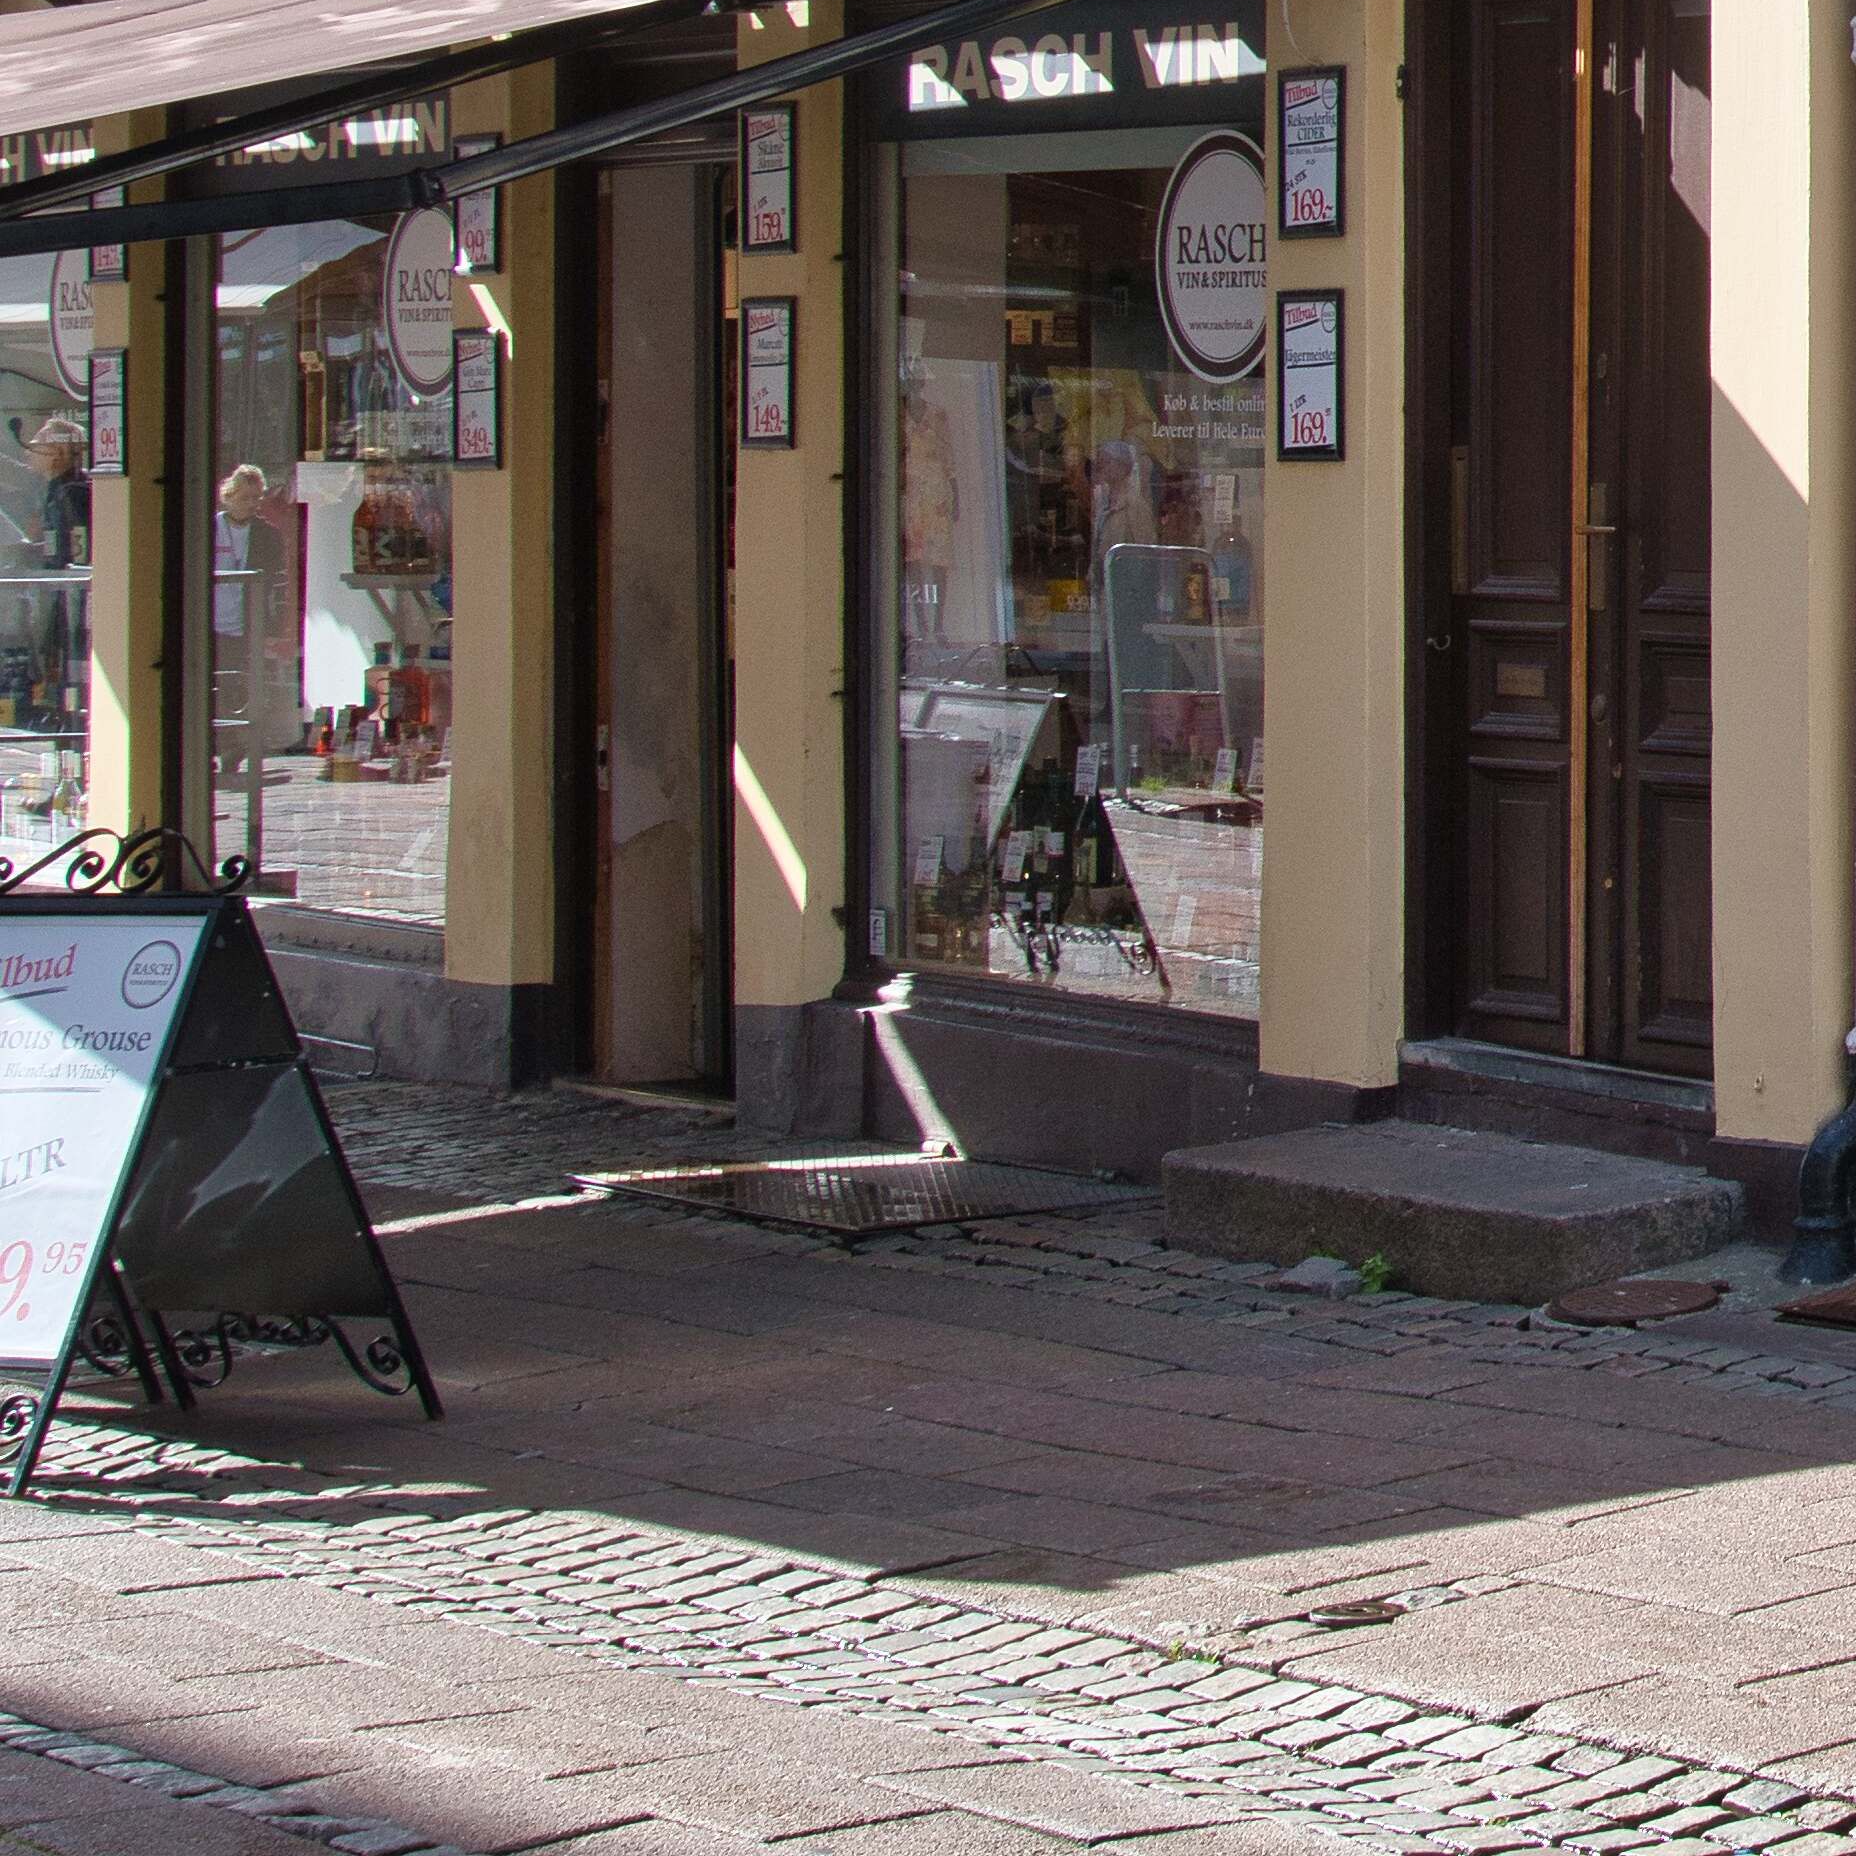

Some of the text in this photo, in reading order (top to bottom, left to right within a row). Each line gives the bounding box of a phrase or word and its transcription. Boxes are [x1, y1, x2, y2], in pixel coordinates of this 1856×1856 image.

[909, 22, 1238, 104] RASCH VIN
[1287, 80, 1318, 104] Tilbud
[372, 100, 446, 153] VIN
[1297, 125, 1325, 141] CIDER
[1176, 223, 1266, 265] RASCH
[60, 280, 94, 312] RAS
[1286, 304, 1318, 326] Tilbud
[0, 943, 78, 988] lbud
[61, 1024, 151, 1052] Grouse
[0, 1136, 67, 1190] LTR
[42, 1241, 89, 1276] 95
